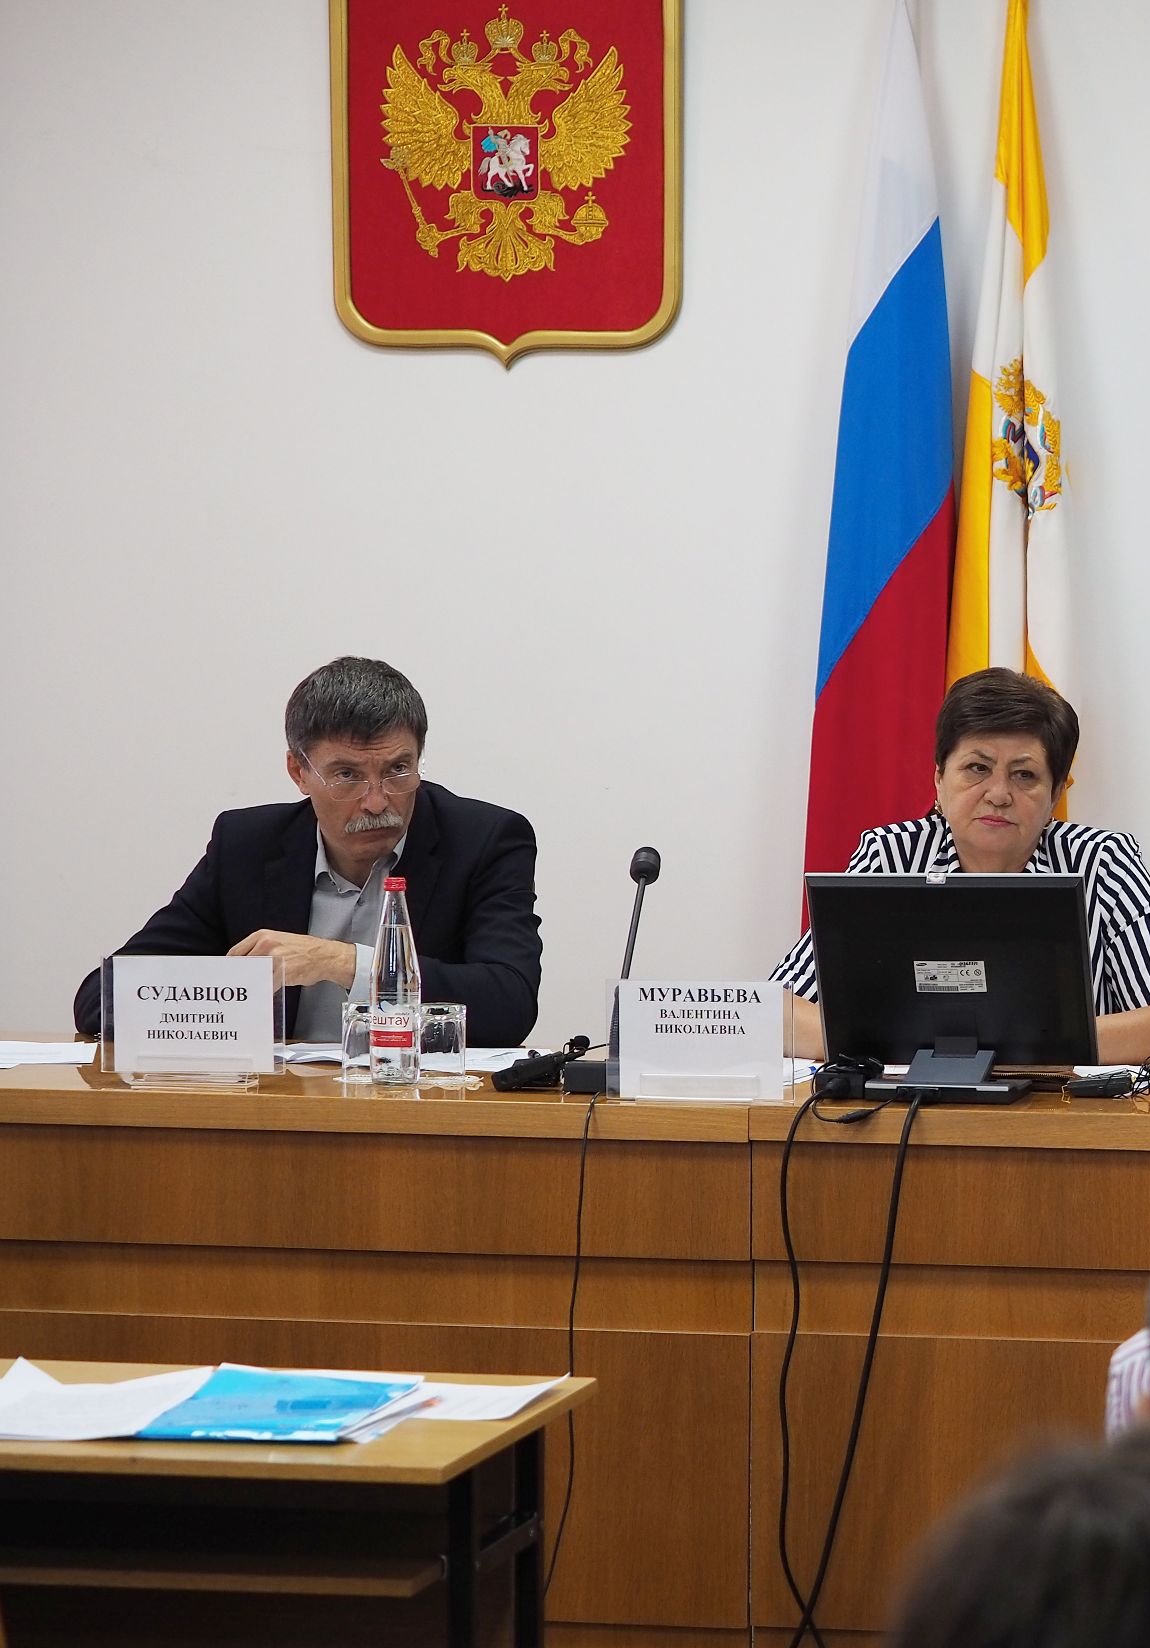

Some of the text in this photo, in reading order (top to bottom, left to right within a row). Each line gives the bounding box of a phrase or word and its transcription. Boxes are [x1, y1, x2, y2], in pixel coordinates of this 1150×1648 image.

[136, 985, 248, 1004] СУДАВЦОВ
[638, 987, 762, 1004] МУРАВЬЕВА
[159, 1011, 225, 1024] ДМИТРИЙ
[659, 1008, 741, 1020] ВАЛЕНТИНА
[146, 1029, 239, 1041] НИКОЛАЕВИЧ
[654, 1023, 746, 1035] НИКОЛАЕВНА
